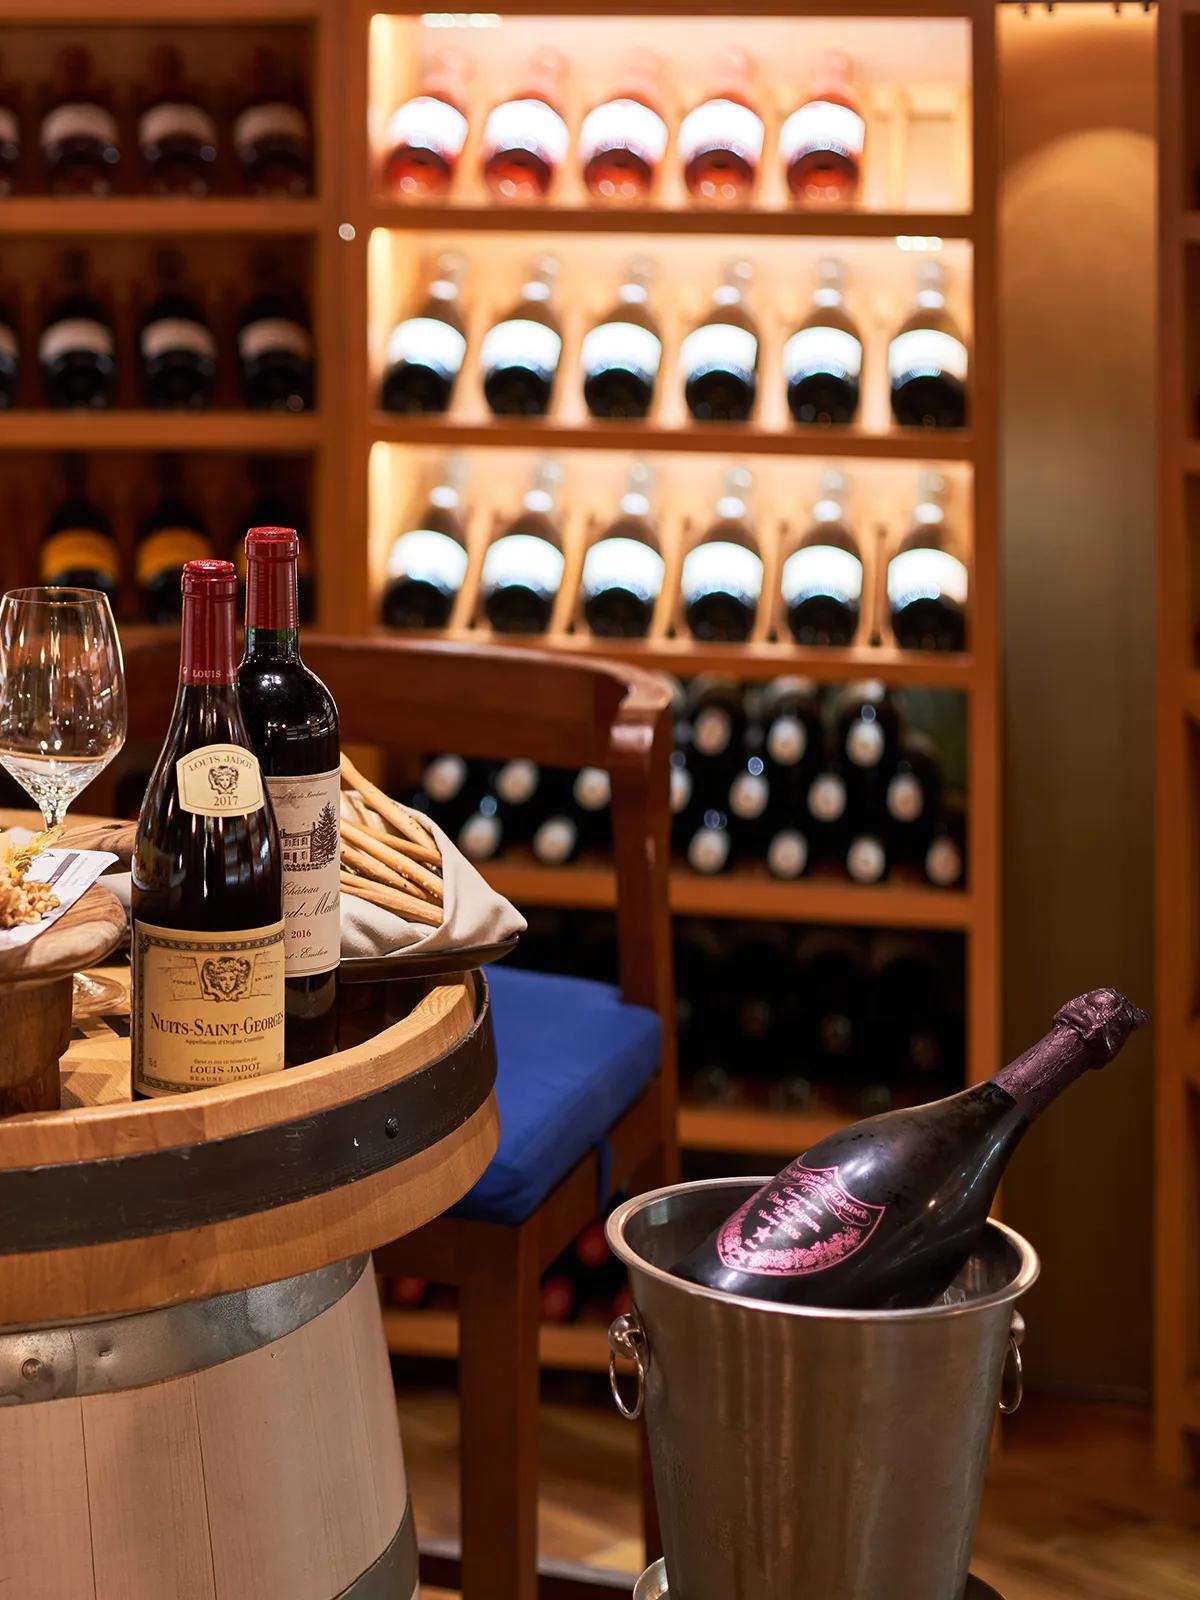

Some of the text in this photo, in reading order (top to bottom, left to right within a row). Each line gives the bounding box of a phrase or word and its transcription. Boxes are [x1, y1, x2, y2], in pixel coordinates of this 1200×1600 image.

[192, 669, 221, 678] LOUIS
[189, 754, 253, 772] LOUIS JADOT
[213, 796, 238, 807] 2017
[291, 929, 312, 939] 2016
[190, 1062, 261, 1074] LOUIS JADOT
